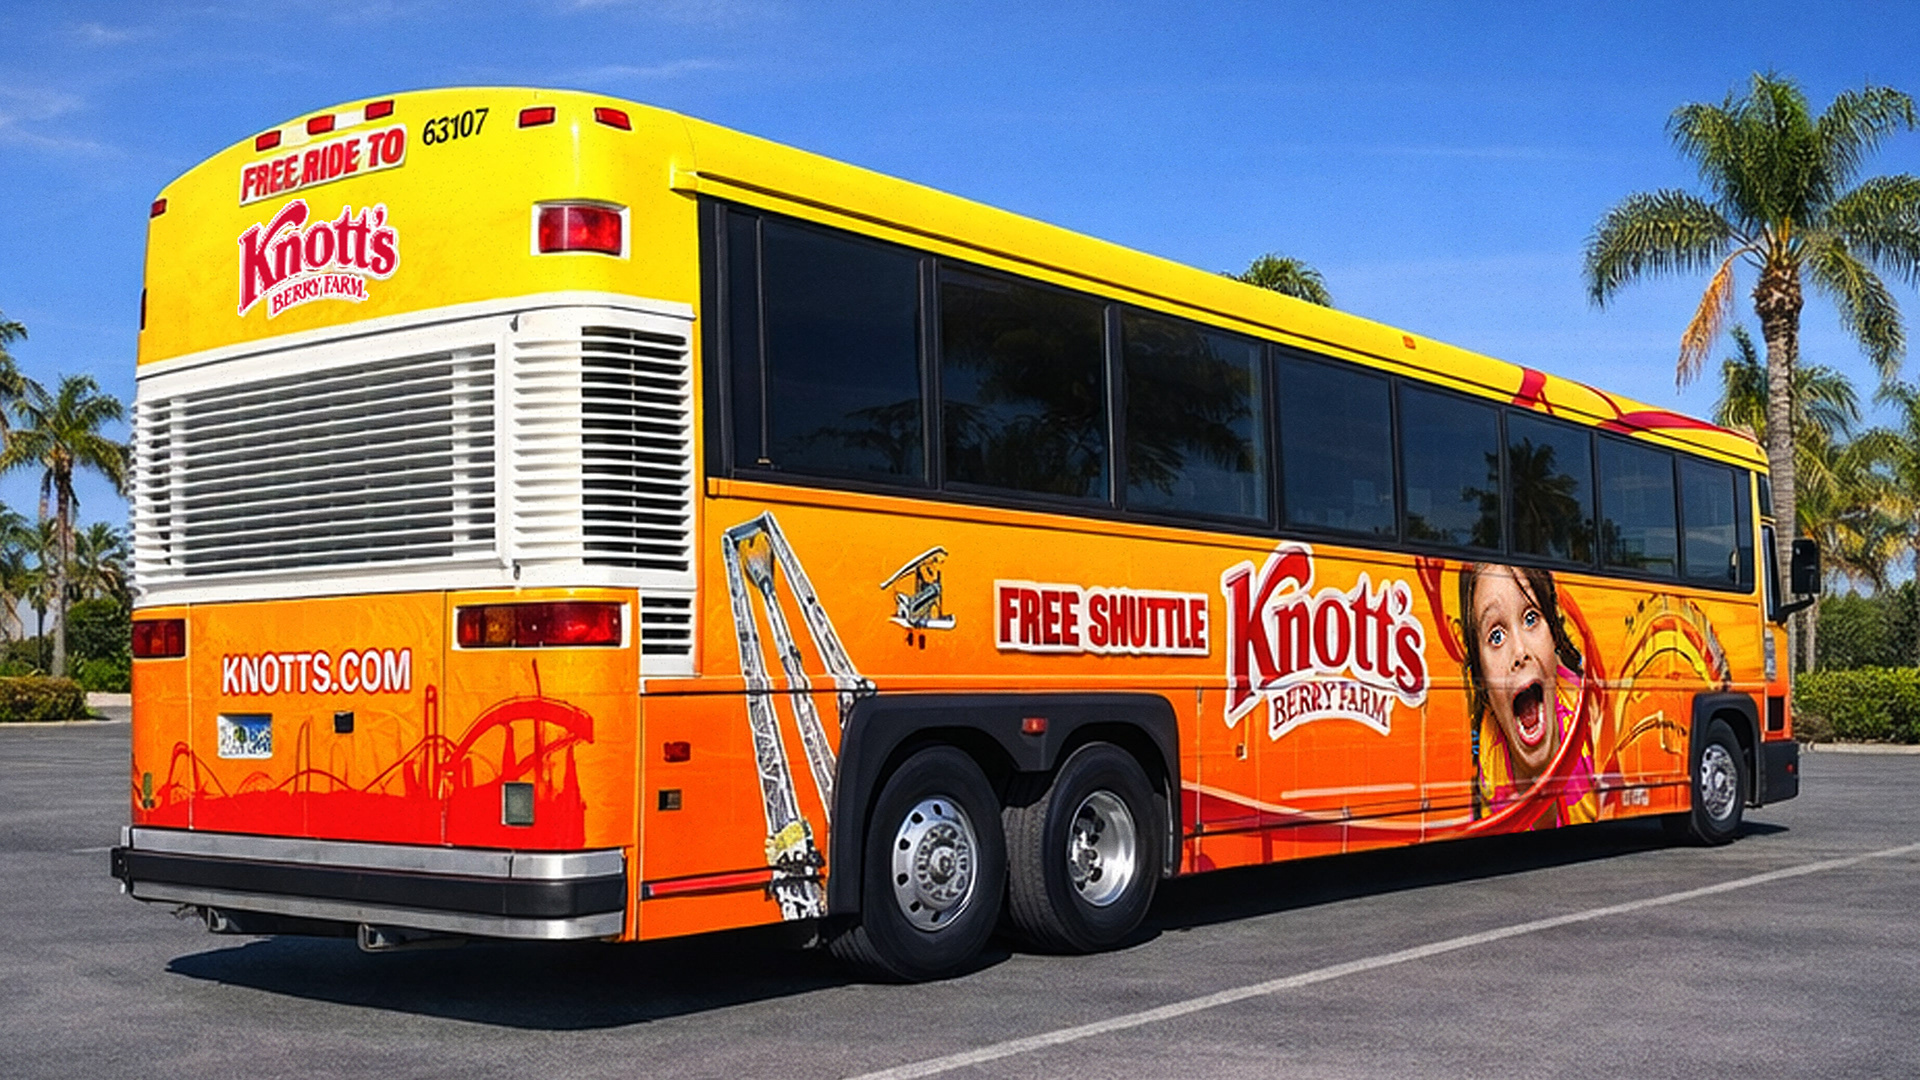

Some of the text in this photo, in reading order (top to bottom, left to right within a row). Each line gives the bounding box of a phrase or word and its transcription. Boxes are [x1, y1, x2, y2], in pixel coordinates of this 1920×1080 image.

[423, 107, 489, 146] 63107
[241, 128, 405, 202] FREE RIDE TO
[238, 200, 397, 314] Knott's
[273, 278, 321, 315] BERRY
[1000, 587, 1206, 648] FREE SHUTTLE
[1227, 547, 1425, 714] Knott's
[222, 649, 412, 694] KNOTTS.COM
[1273, 681, 1389, 730] BERRY FARM
